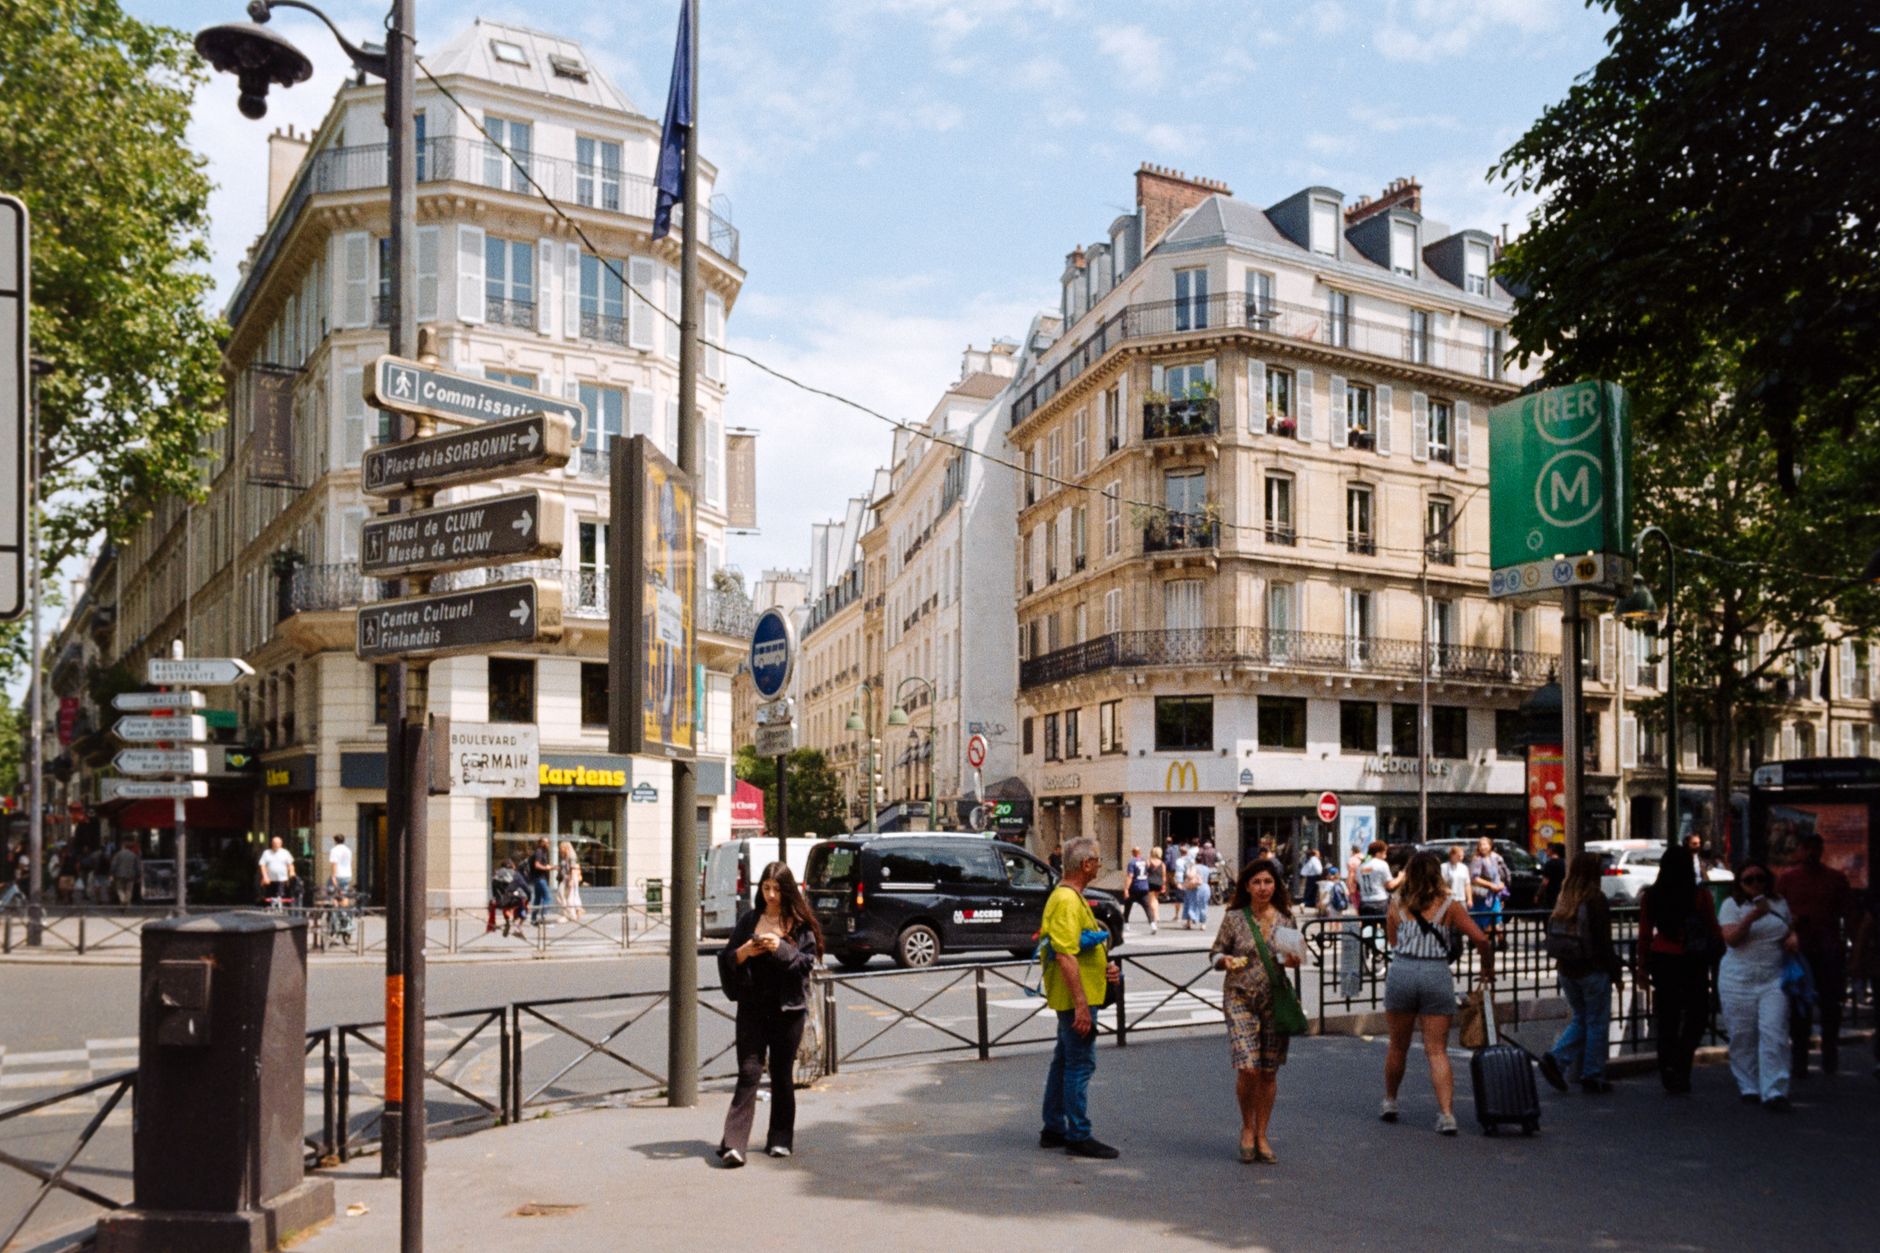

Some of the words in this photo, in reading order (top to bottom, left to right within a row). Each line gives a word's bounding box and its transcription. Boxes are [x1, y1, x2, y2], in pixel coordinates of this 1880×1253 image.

[1543, 388, 1598, 423] RER
[384, 457, 415, 476] Place
[417, 451, 431, 469] de
[432, 449, 443, 466] la
[445, 433, 518, 464] SORBONNE
[1551, 464, 1590, 512] M
[388, 520, 418, 541] Hôtel
[424, 518, 438, 537] de
[445, 509, 486, 532] CLUNY
[388, 542, 425, 564] Musée
[431, 538, 446, 557] de
[452, 530, 493, 553] CLUNY
[381, 607, 419, 629] Centre
[423, 599, 474, 621] Culturel
[381, 628, 441, 650] Finlandais
[452, 734, 517, 746] BOULEVARD
[1364, 756, 1451, 775] McDonld's
[973, 909, 1003, 918] ACCESS
